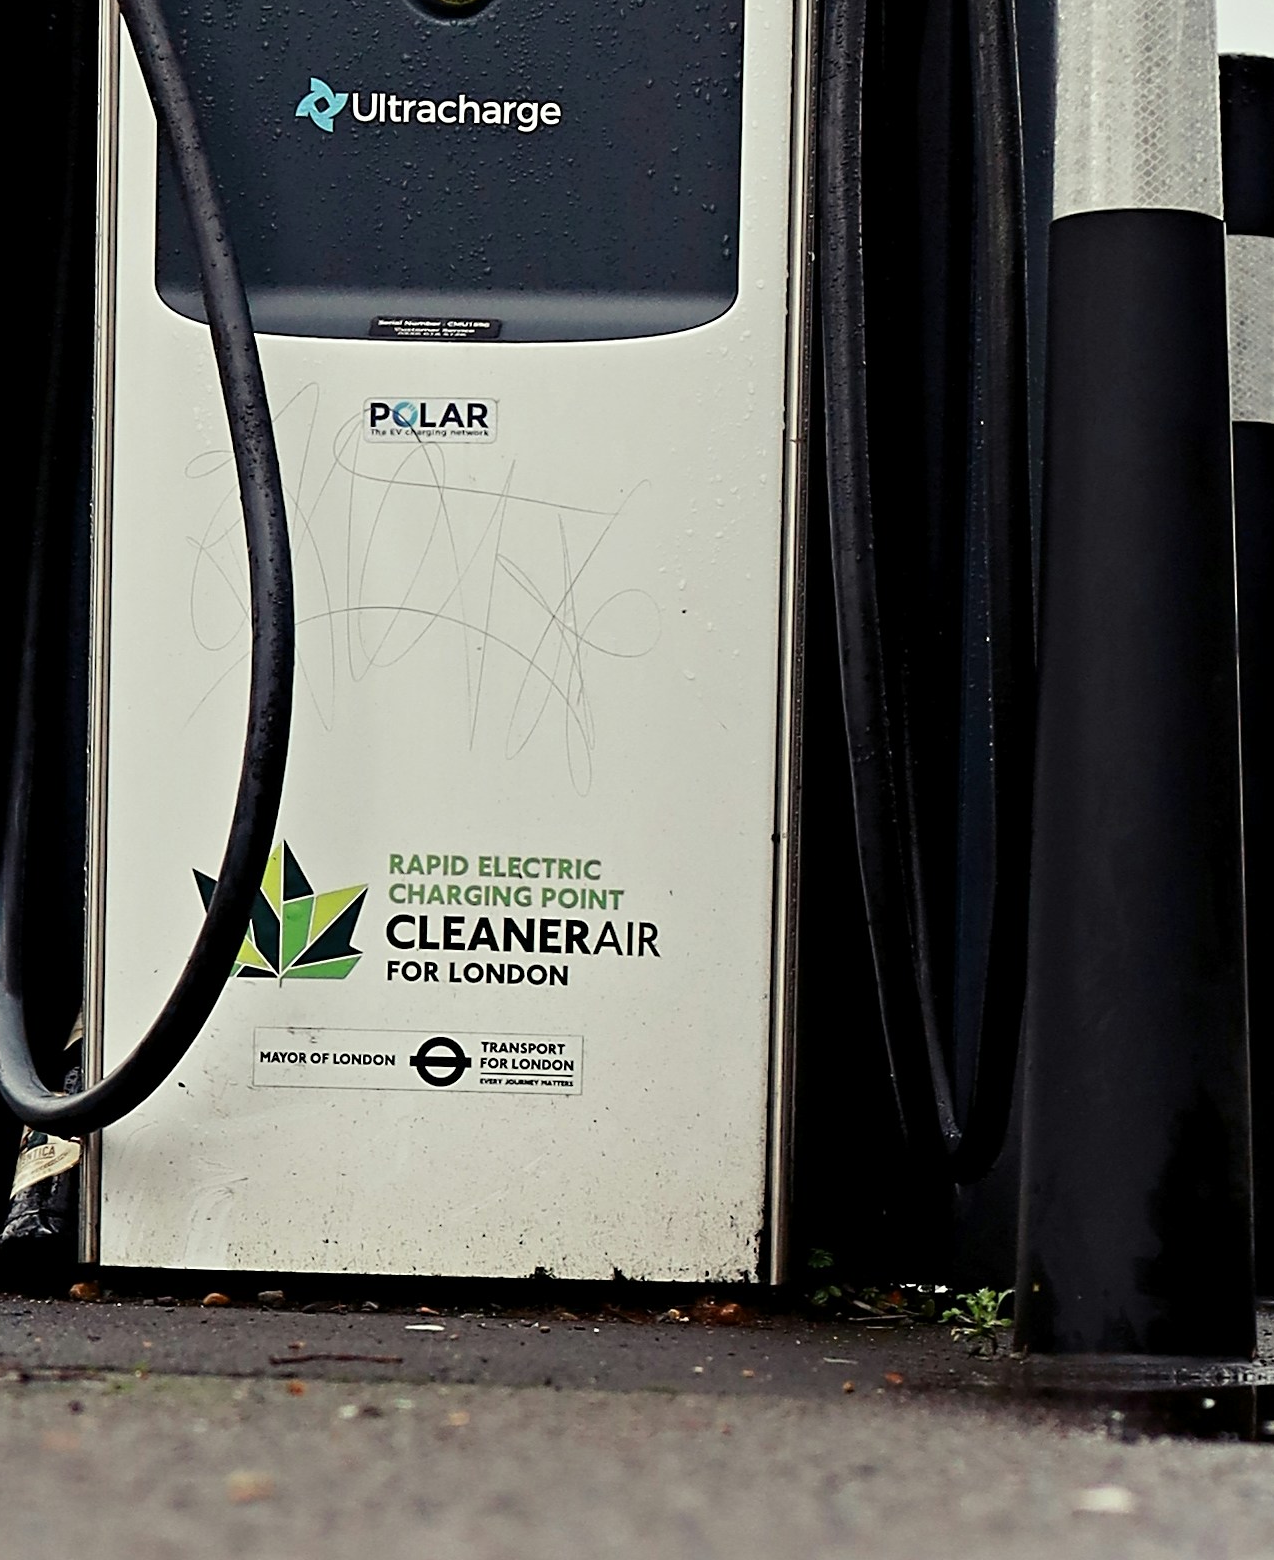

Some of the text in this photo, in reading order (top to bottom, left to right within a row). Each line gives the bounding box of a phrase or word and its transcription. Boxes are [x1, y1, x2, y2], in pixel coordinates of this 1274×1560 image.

[352, 92, 561, 132] Ultracharge
[370, 401, 489, 428] POLAR
[371, 428, 489, 438] The EV charging network
[389, 853, 602, 880] RAPID ELECTRIC
[388, 883, 624, 910] CHARGING POINT
[387, 960, 569, 986] FOR LONDON
[260, 1051, 395, 1066] MAYOR OF LONDON
[481, 1041, 565, 1055] TRANSPORT
[480, 1057, 574, 1071] FOR LONDON
